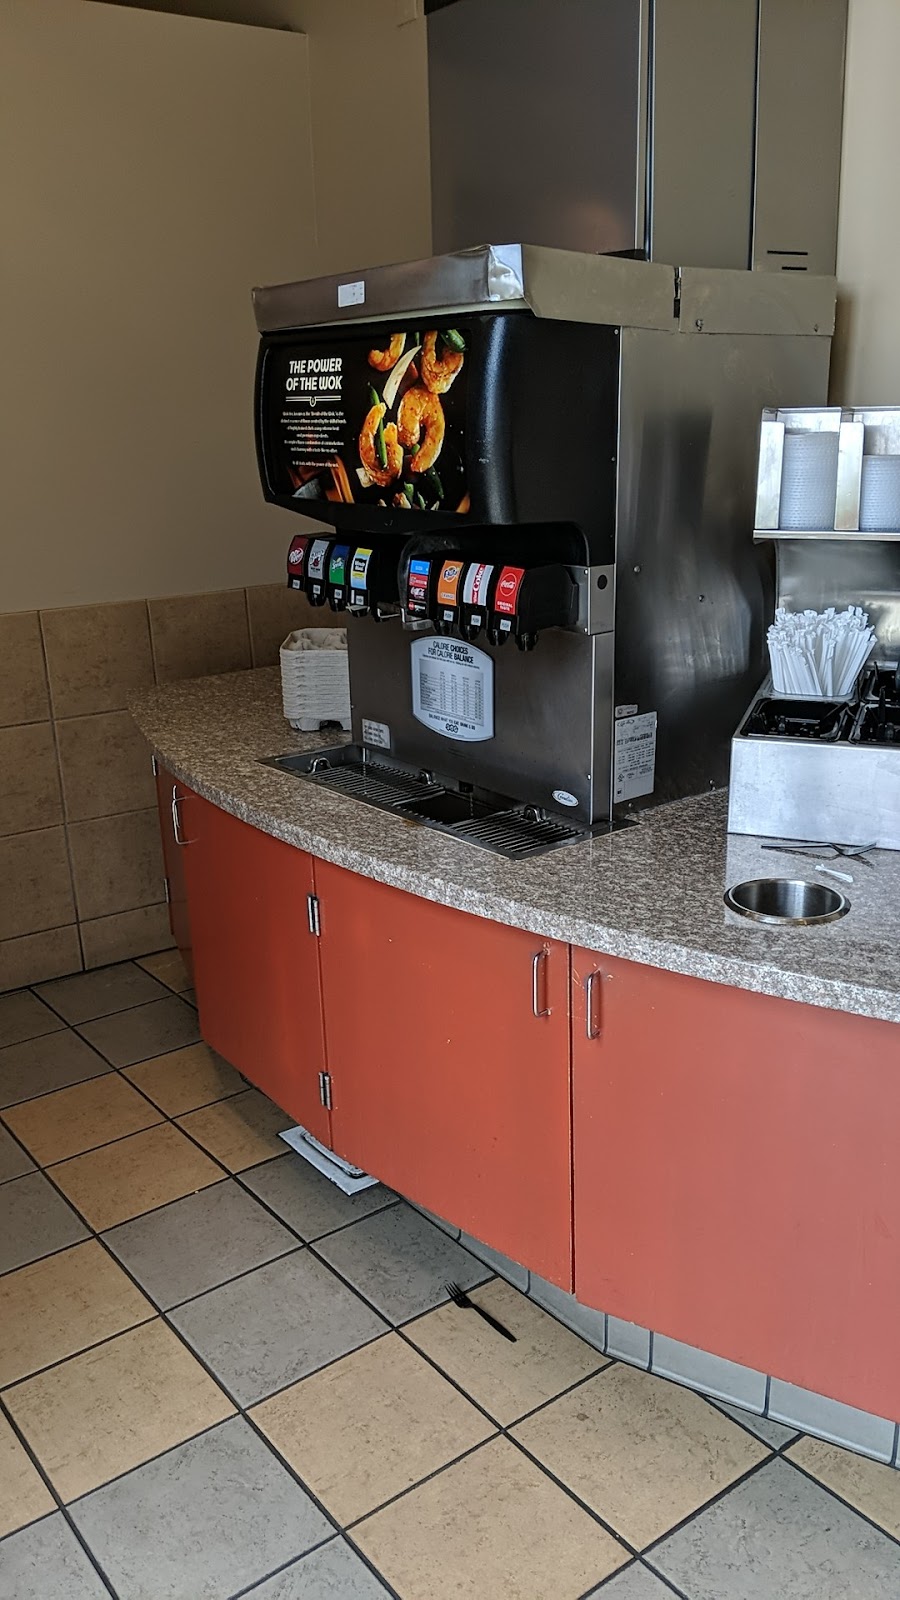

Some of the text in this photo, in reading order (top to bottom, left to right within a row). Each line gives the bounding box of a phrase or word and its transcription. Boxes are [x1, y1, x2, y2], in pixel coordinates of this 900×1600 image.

[289, 358, 342, 374] THE POWER
[286, 375, 343, 391] OF THE WOK
[428, 647, 436, 656] FOR
[454, 653, 474, 664] BALANCE
[450, 644, 469, 655] CHOICES
